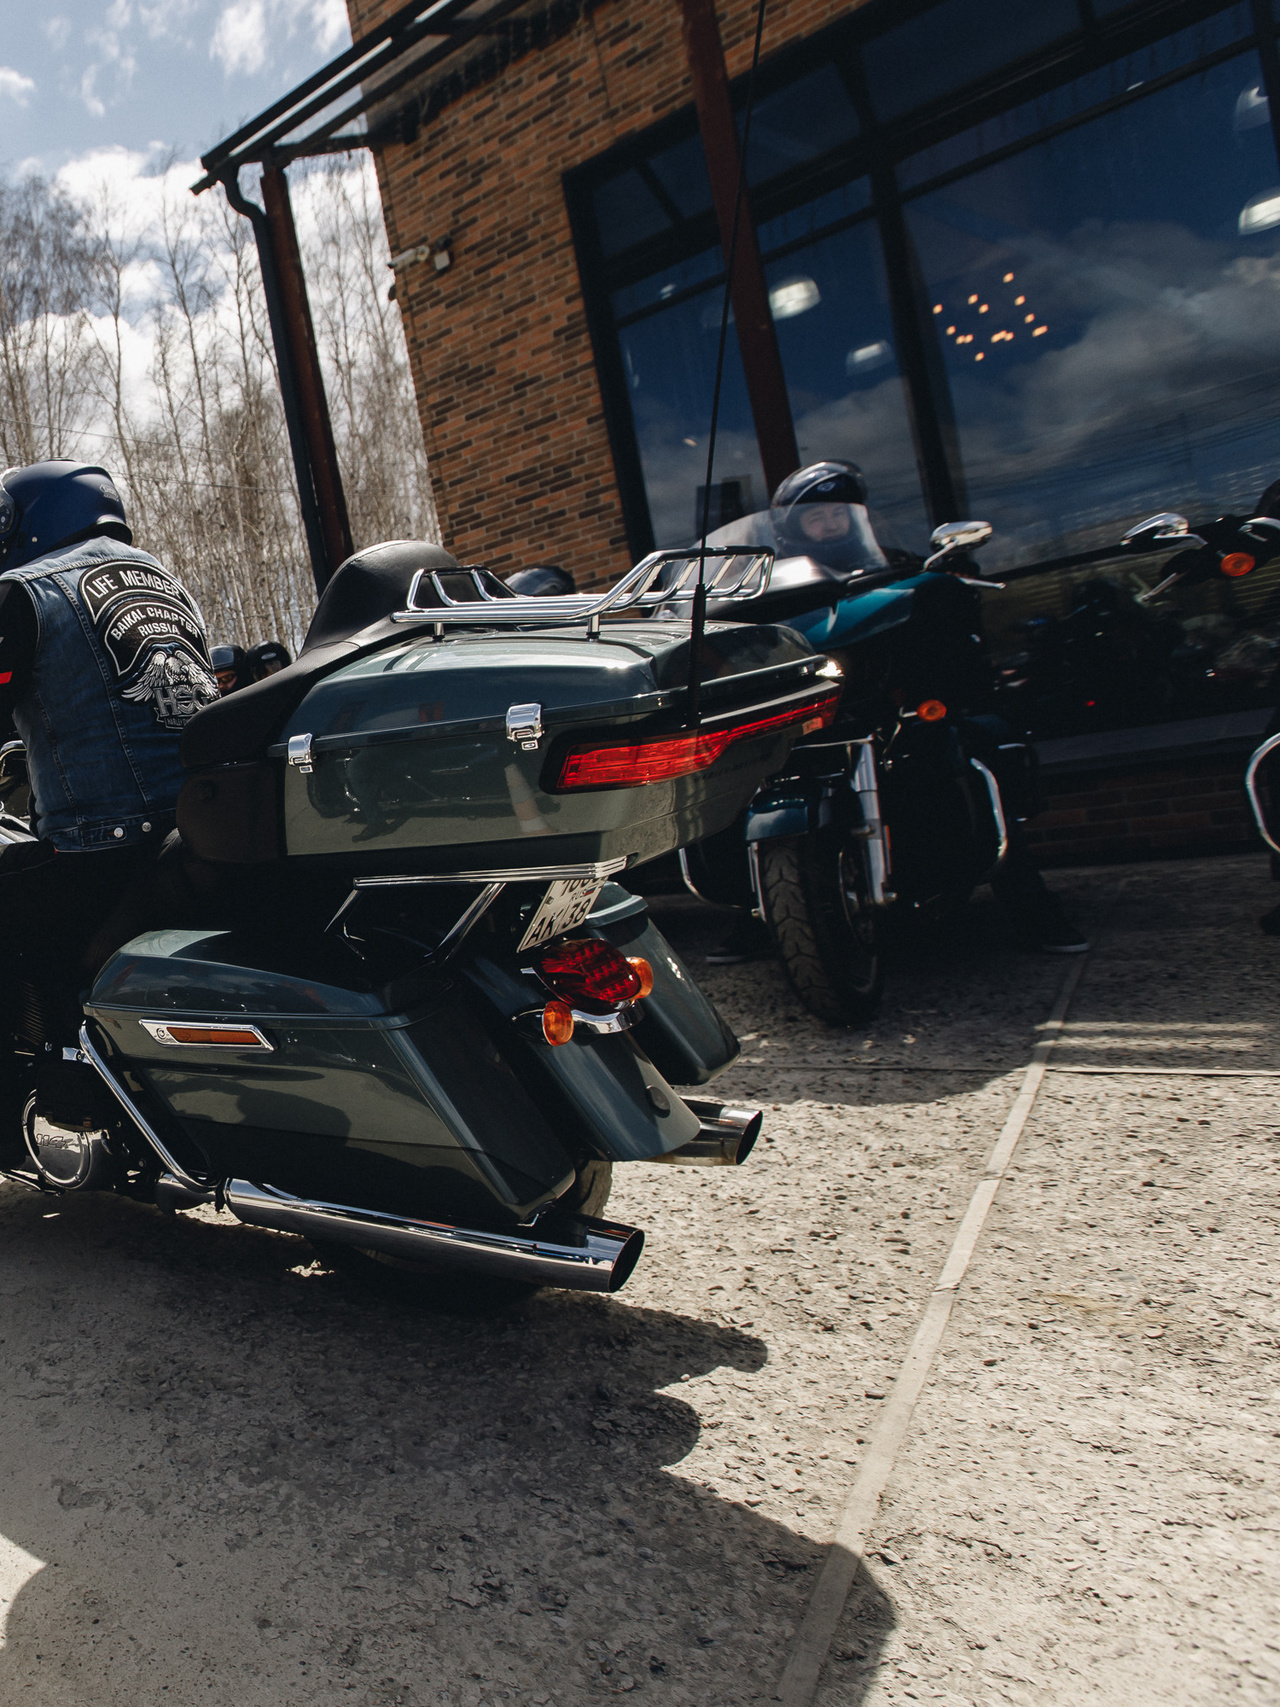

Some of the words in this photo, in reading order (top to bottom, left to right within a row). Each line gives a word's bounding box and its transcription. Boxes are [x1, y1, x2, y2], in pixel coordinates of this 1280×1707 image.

[86, 574, 119, 599] LIFE
[119, 570, 181, 599] MEMBER
[111, 608, 146, 641] BAIKAL
[147, 607, 199, 639] CHAPTER
[137, 622, 180, 637] RUSSIA
[523, 908, 564, 946] AK
[562, 897, 591, 929] 38
